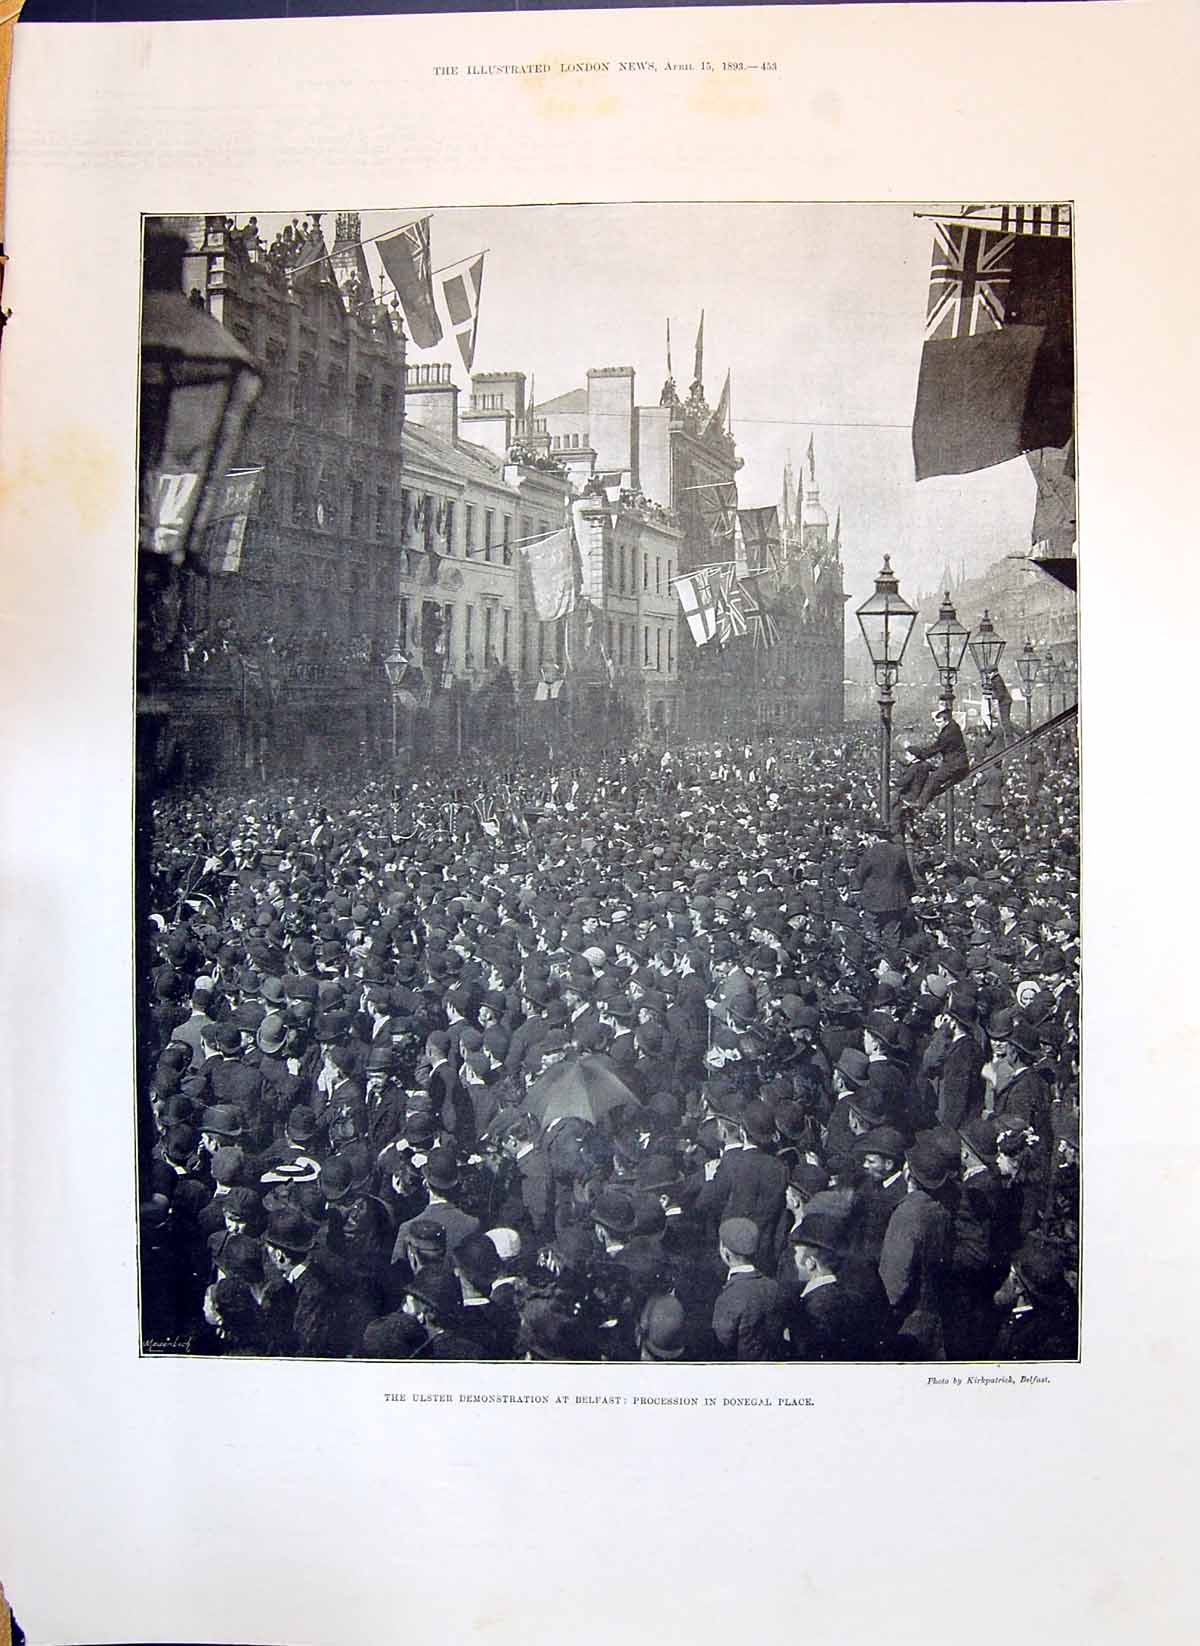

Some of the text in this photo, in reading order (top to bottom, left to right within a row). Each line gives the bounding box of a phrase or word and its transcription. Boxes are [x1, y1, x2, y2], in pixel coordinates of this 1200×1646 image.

[434, 66, 459, 76] THE
[467, 64, 551, 75] ILLUSTRATED
[560, 63, 611, 73] LONDON
[618, 62, 658, 74] NEWS,
[701, 61, 715, 72] 15,
[927, 1375, 1051, 1387] Photo by Kirkpatrick, Belfast.
[384, 1393, 407, 1402] THE
[412, 1393, 454, 1402] ULSTER
[459, 1394, 550, 1404] DEMONSTRATION
[555, 1395, 570, 1405] AT
[633, 1396, 699, 1407] PROCESSION
[704, 1397, 717, 1407] IN
[723, 1397, 773, 1407] DONEGAL
[778, 1397, 816, 1407] PLACE.
